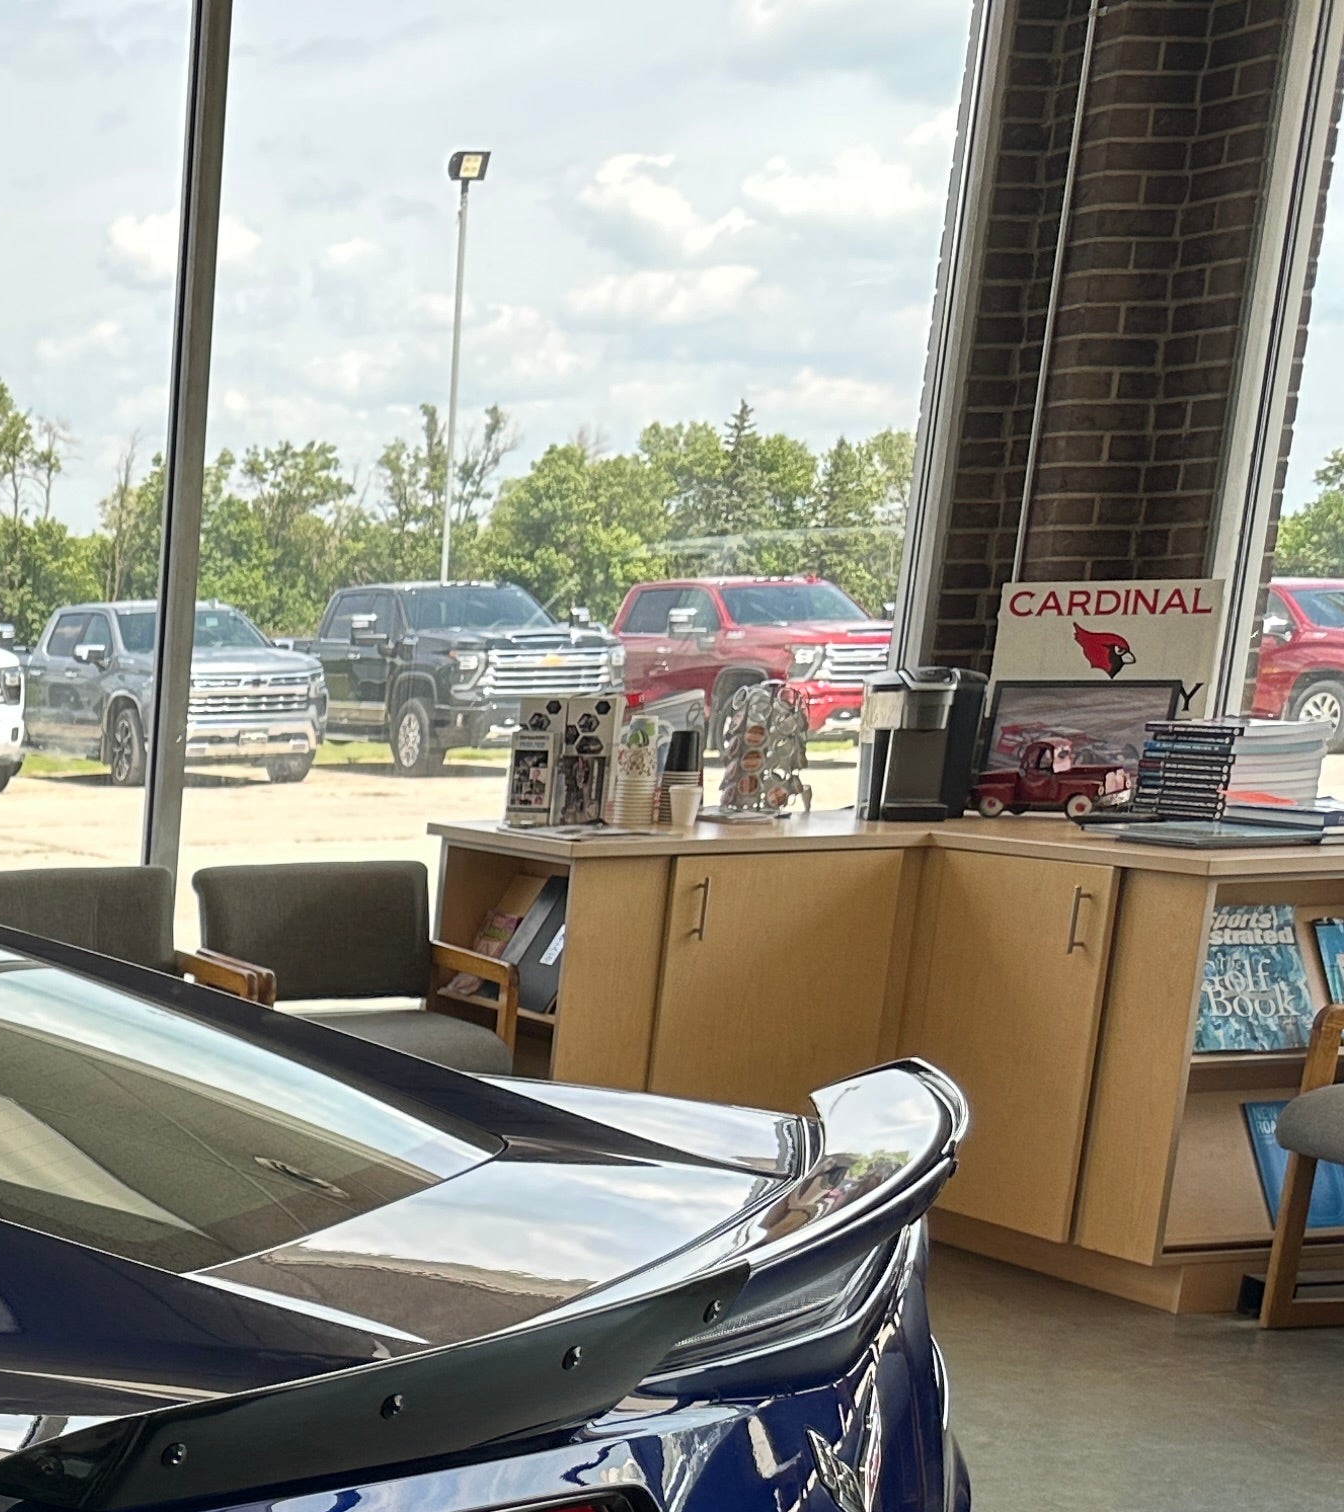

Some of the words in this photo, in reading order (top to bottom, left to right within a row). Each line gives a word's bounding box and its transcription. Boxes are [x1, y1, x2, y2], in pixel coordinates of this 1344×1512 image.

[1009, 587, 1212, 617] CARDINAL
[1211, 911, 1272, 929] ports
[1209, 927, 1295, 945] strated
[1208, 981, 1301, 1017] Book
